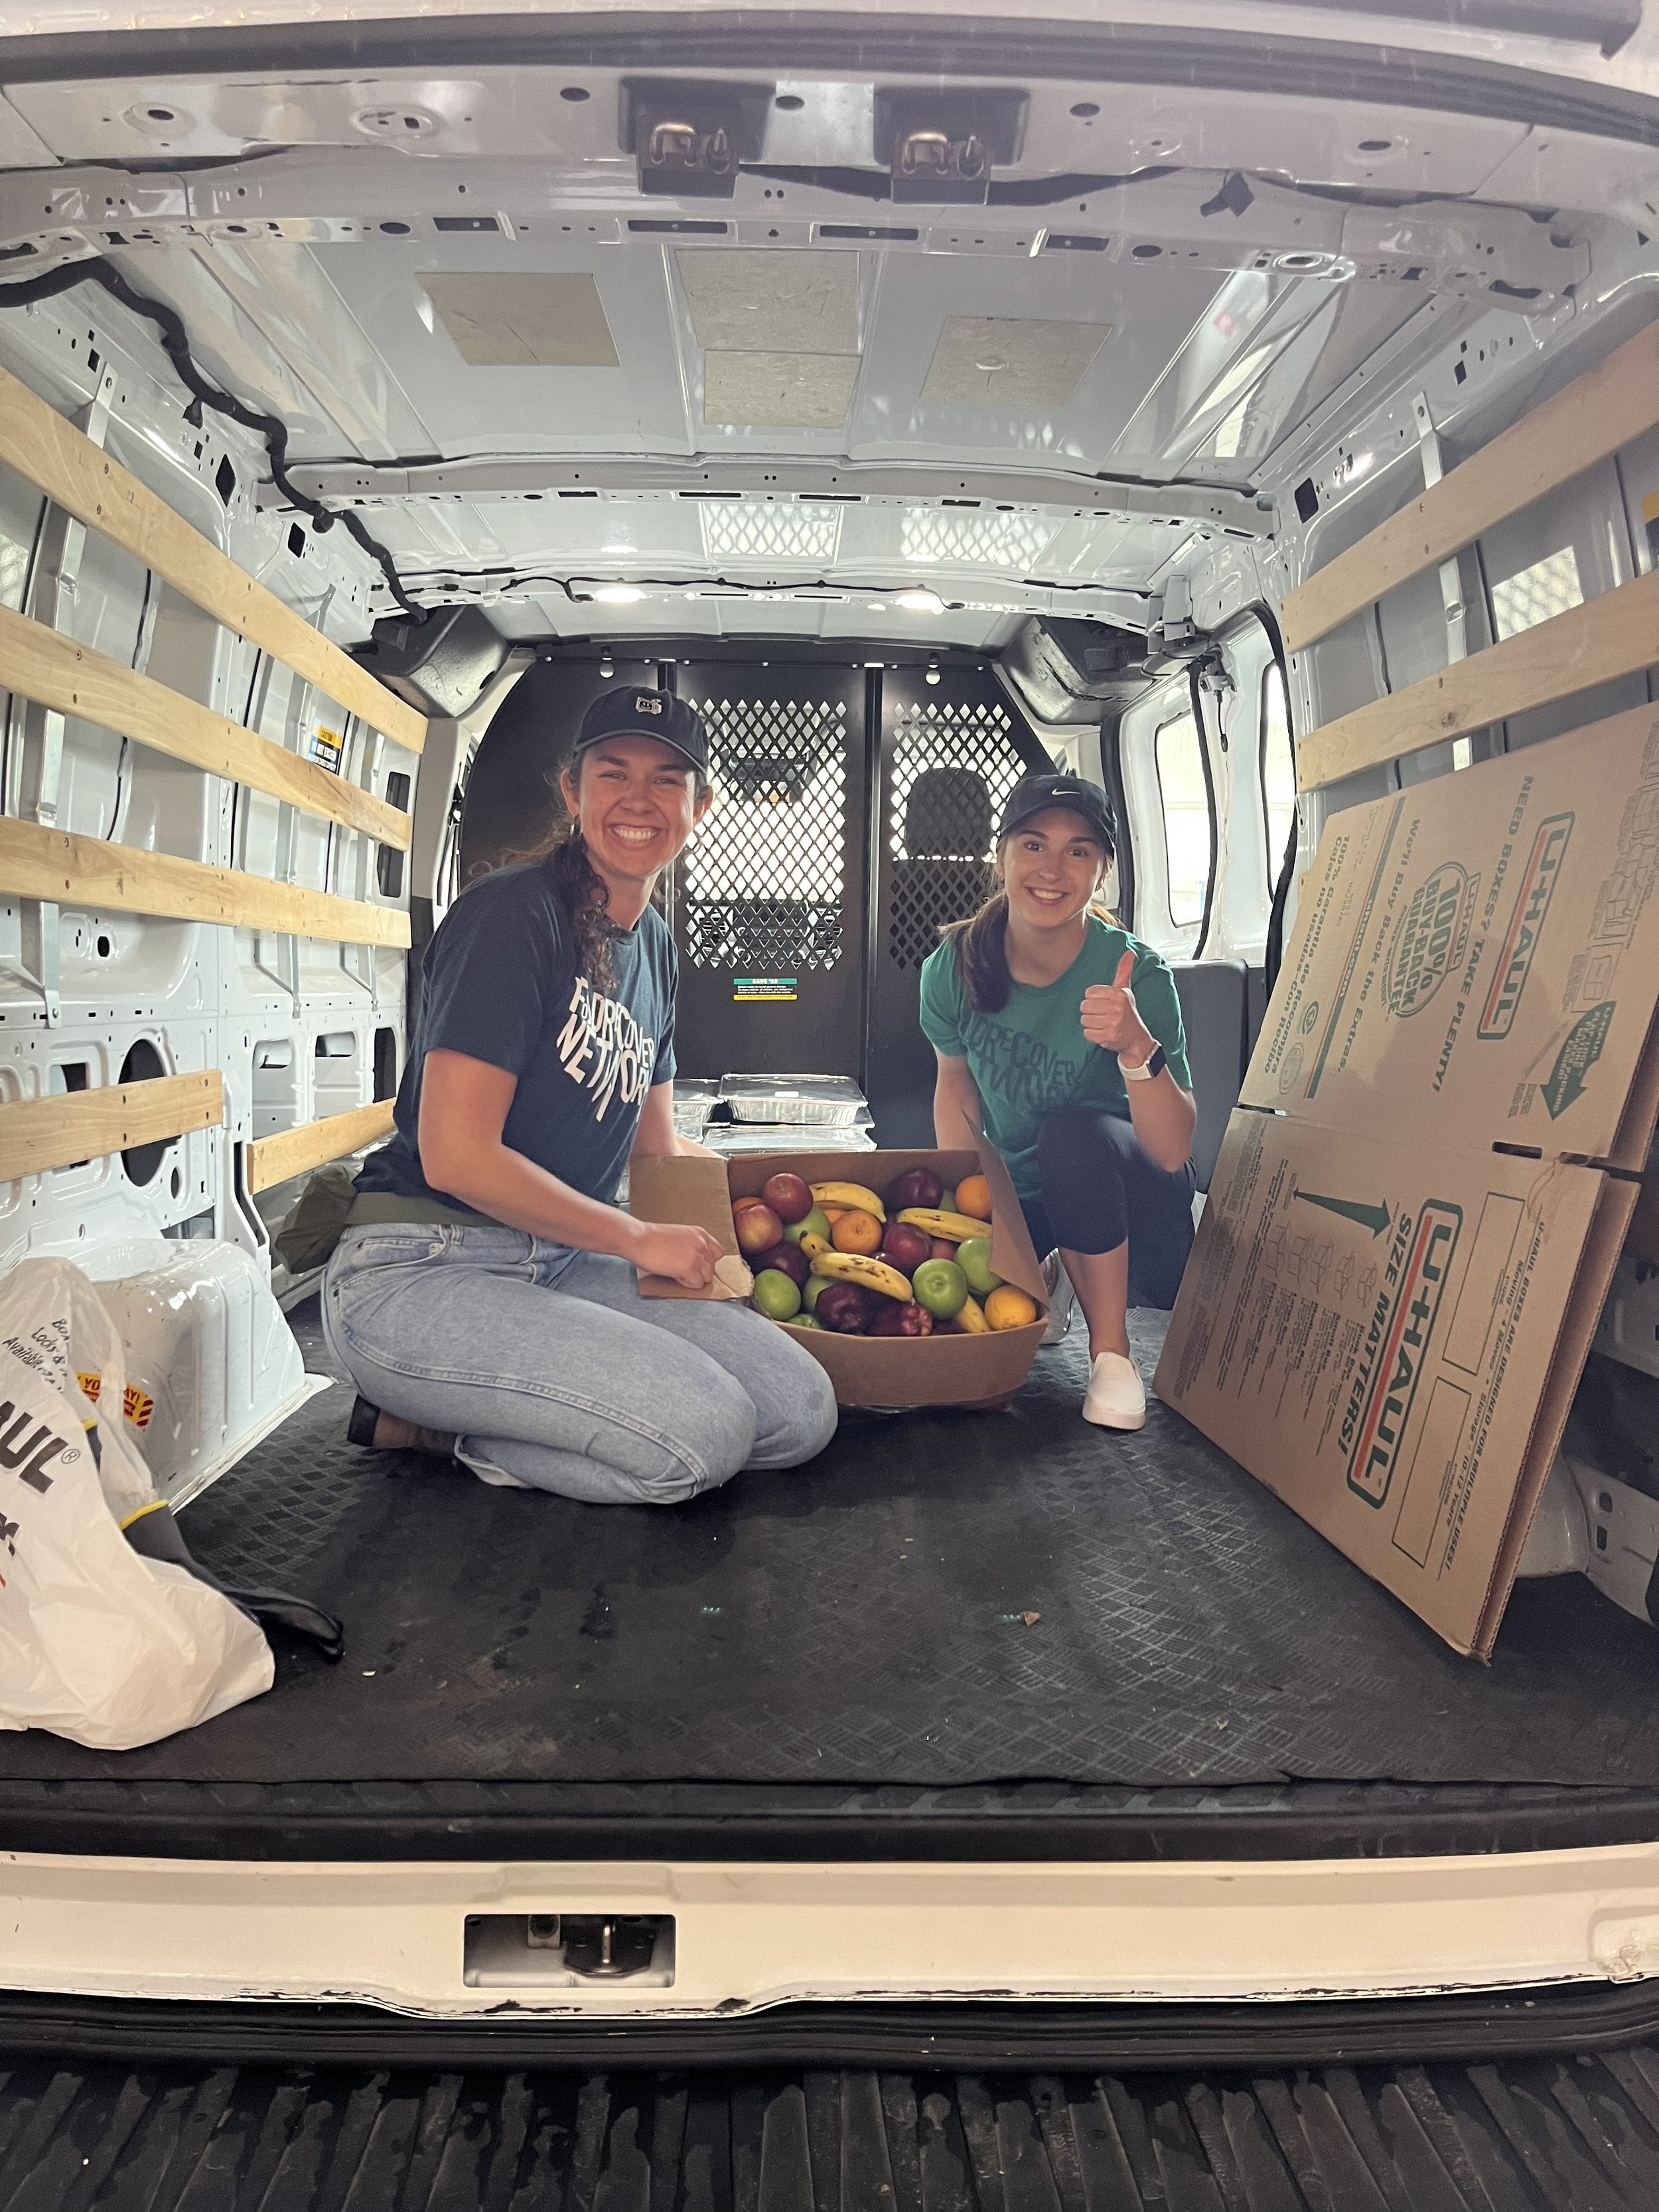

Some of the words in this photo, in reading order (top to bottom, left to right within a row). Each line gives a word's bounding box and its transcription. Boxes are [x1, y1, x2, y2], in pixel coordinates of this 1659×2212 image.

[1507, 777, 1533, 834] NEED
[1323, 836, 1342, 881] Cajas
[1331, 836, 1350, 881] 100%
[1400, 818, 1420, 865] We'll
[1316, 887, 1325, 908] no
[1385, 871, 1404, 909] Buy
[1479, 844, 1512, 929] BOXES?
[1307, 887, 1334, 956] Garantía
[1370, 915, 1391, 964] Back
[1399, 879, 1441, 1009] BUY-BACK
[1418, 879, 1463, 988] 100%
[1338, 898, 1374, 999] uhaul.com
[1386, 885, 1427, 1013] GUARANTEE
[1459, 939, 1484, 994] TAKE
[1299, 963, 1311, 984] de
[1358, 970, 1375, 1002] the
[1263, 1013, 1287, 1074] Recibo
[1270, 989, 1303, 1074] Recompra
[1336, 1007, 1363, 1074] Extras.
[1430, 1001, 1465, 1092] PLENTY!
[1385, 1213, 1411, 1286] SIZE
[1527, 1221, 1545, 1272] U-HAUL
[1506, 1260, 1523, 1305] Moving
[1513, 1277, 1530, 1322] BOXES
[1302, 1302, 1319, 1347] Medium
[1328, 1314, 1341, 1345] Small
[1352, 1325, 1365, 1354] Book
[1504, 1325, 1516, 1353] ARE
[2, 1337, 44, 1369] Available
[1321, 1349, 1331, 1370] Box
[1345, 1359, 1355, 1380] Box
[1488, 1329, 1504, 1370] Moves
[1337, 1291, 1389, 1455] MATTERS!
[1484, 1356, 1507, 1425] DESIGNED
[1468, 1392, 1486, 1441] Storage
[1476, 1428, 1487, 1456] FOR
[1455, 1455, 1469, 1489] 10-12
[1457, 1459, 1479, 1524] MULTIPLE
[1445, 1492, 1459, 1527] Years
[1445, 1527, 1460, 1570] USES!
